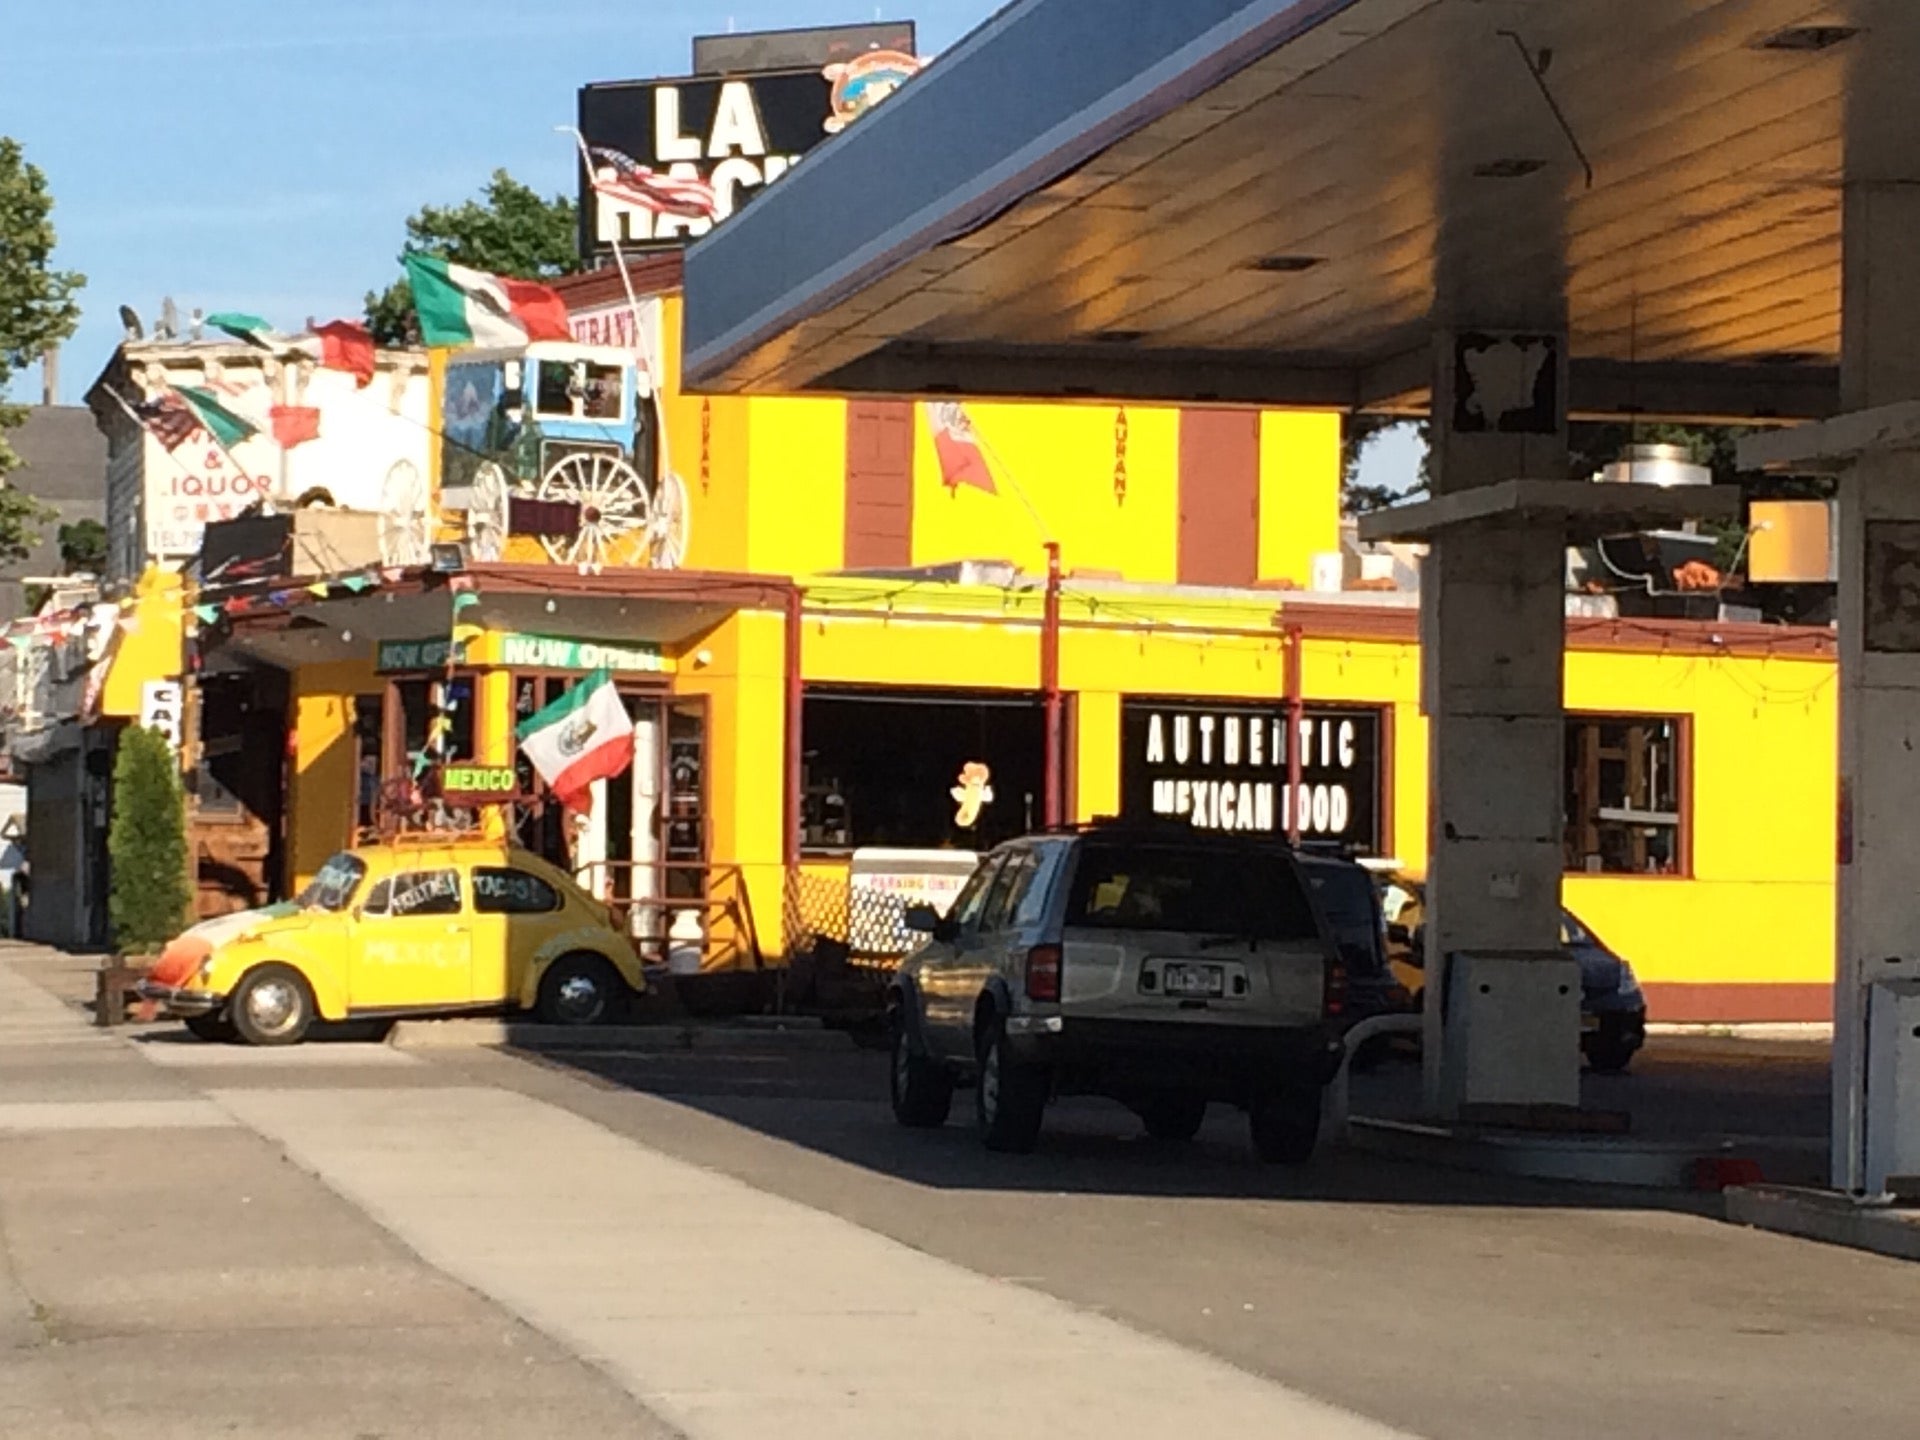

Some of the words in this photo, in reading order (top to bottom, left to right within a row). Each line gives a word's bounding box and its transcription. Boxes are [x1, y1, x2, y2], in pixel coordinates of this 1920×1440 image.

[654, 80, 767, 161] LA
[204, 450, 223, 469] &
[160, 475, 272, 496] IQUOR
[503, 637, 568, 665] NOW
[445, 769, 514, 791] MEXICO
[1153, 780, 1273, 831] MEXICAN
